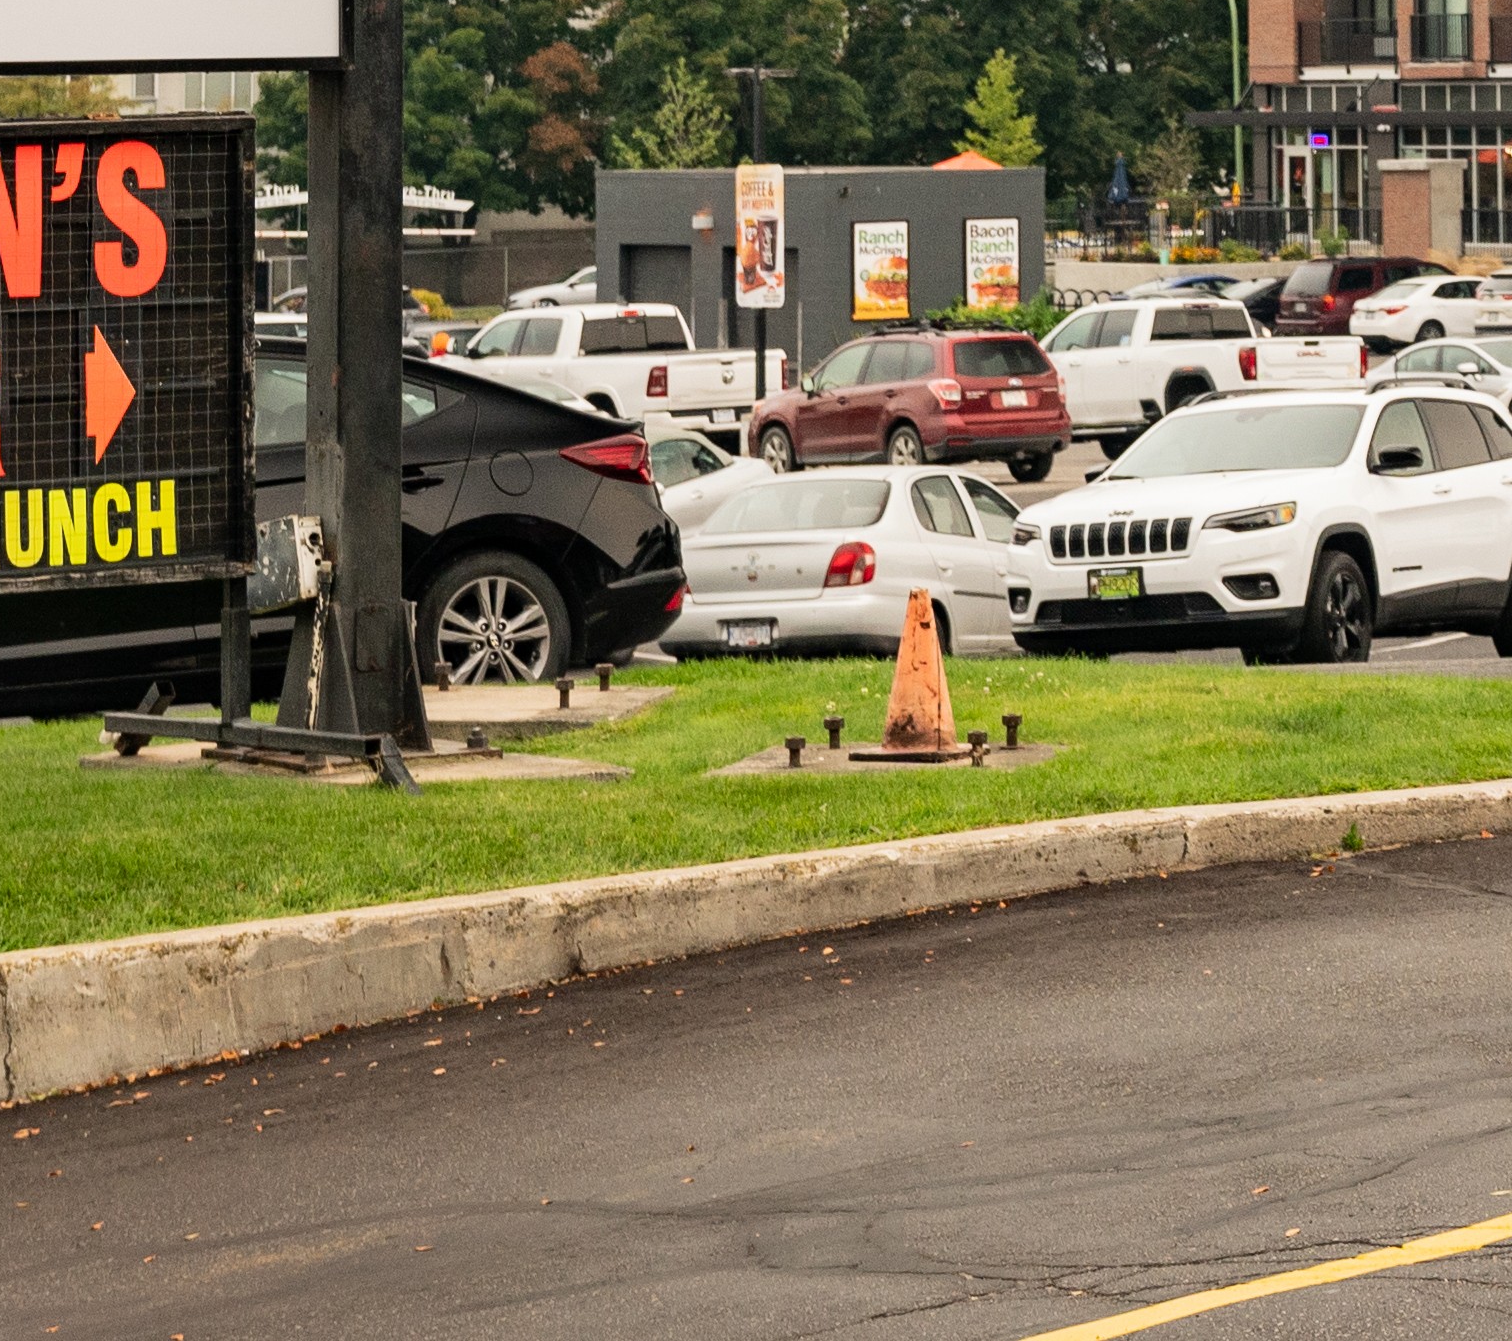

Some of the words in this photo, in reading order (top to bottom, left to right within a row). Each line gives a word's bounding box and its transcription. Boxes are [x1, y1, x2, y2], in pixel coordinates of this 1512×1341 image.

[741, 181, 766, 197] COFFEE
[858, 229, 904, 245] Ranch
[970, 225, 1014, 238] Bacon
[859, 246, 903, 256] McCrispy
[970, 240, 1014, 254] Ranch
[971, 254, 1014, 265] McCrispy
